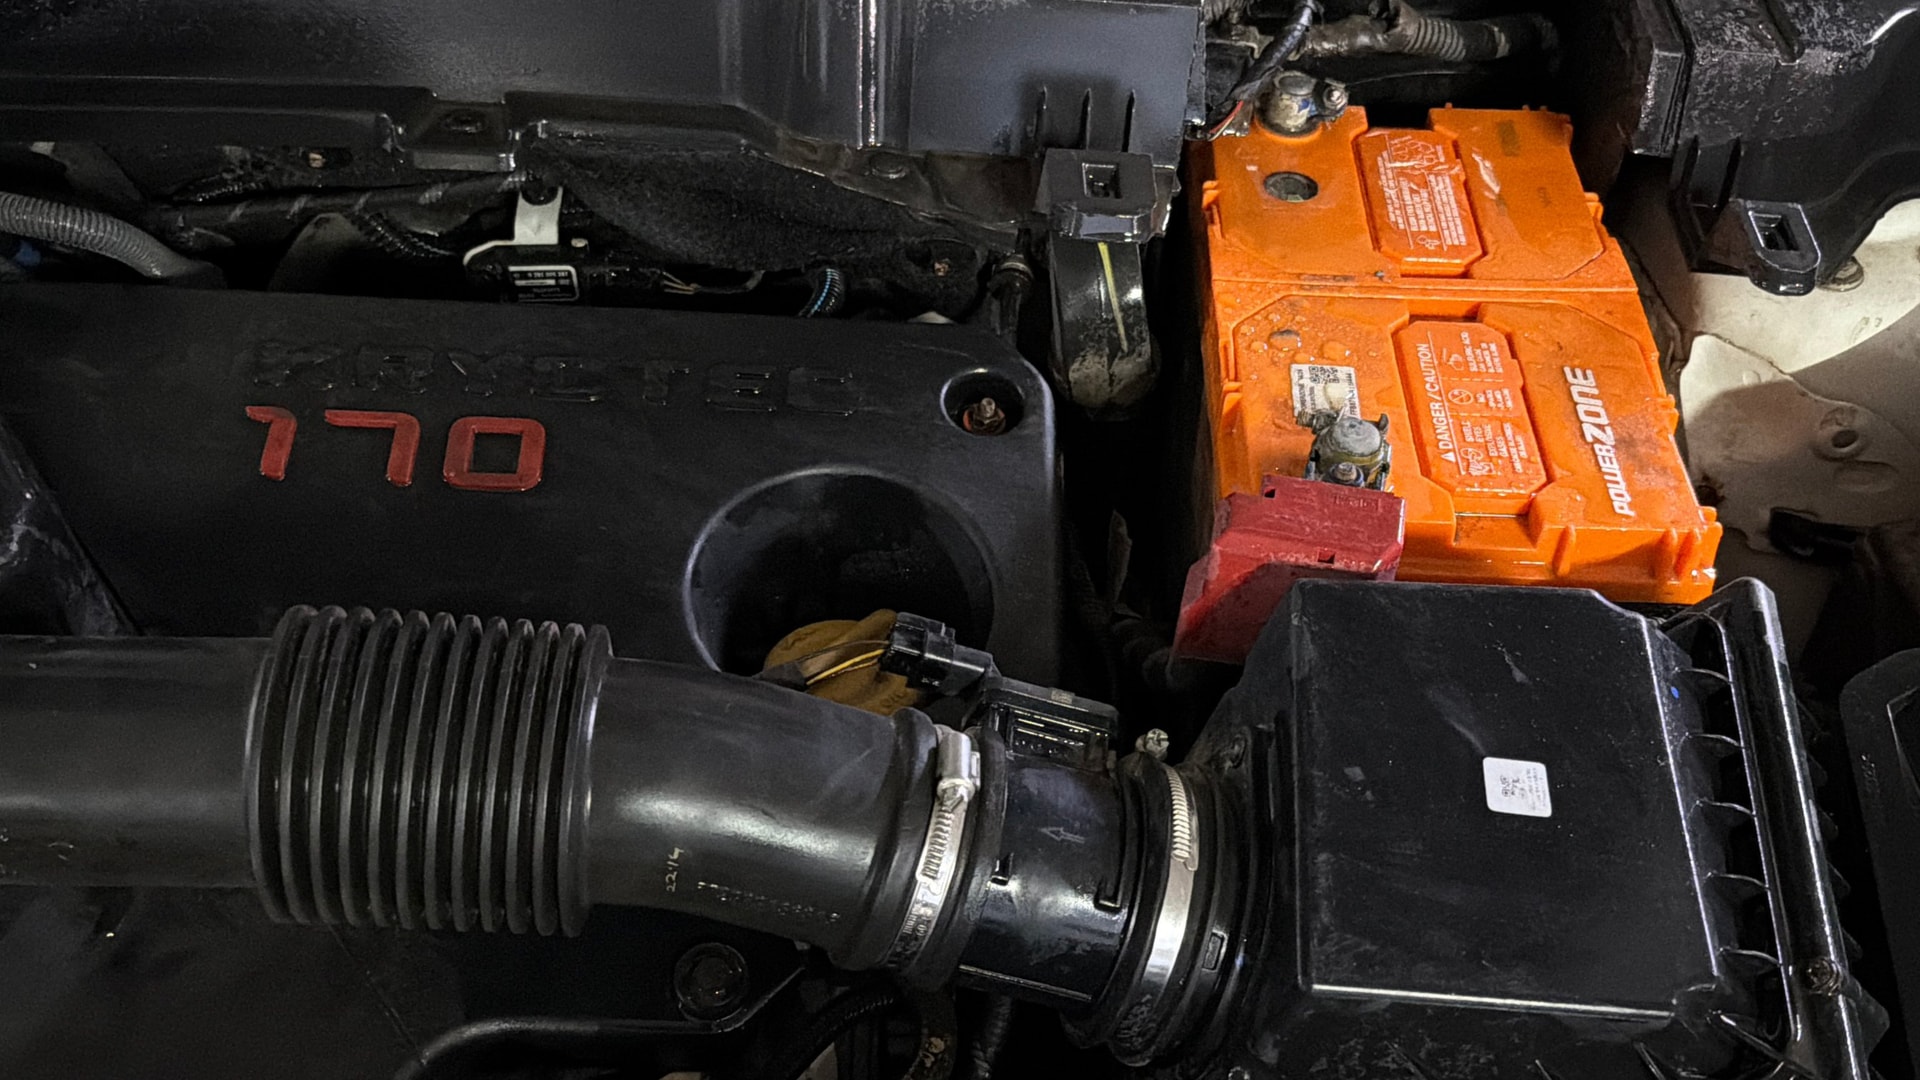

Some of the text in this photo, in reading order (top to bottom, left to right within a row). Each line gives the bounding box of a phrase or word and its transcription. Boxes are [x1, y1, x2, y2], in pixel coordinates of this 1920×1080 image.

[1417, 344, 1438, 391] CAUTION
[245, 404, 547, 493] 170
[1429, 403, 1452, 449] DANGER
[1563, 366, 1635, 516] POWERZONE
